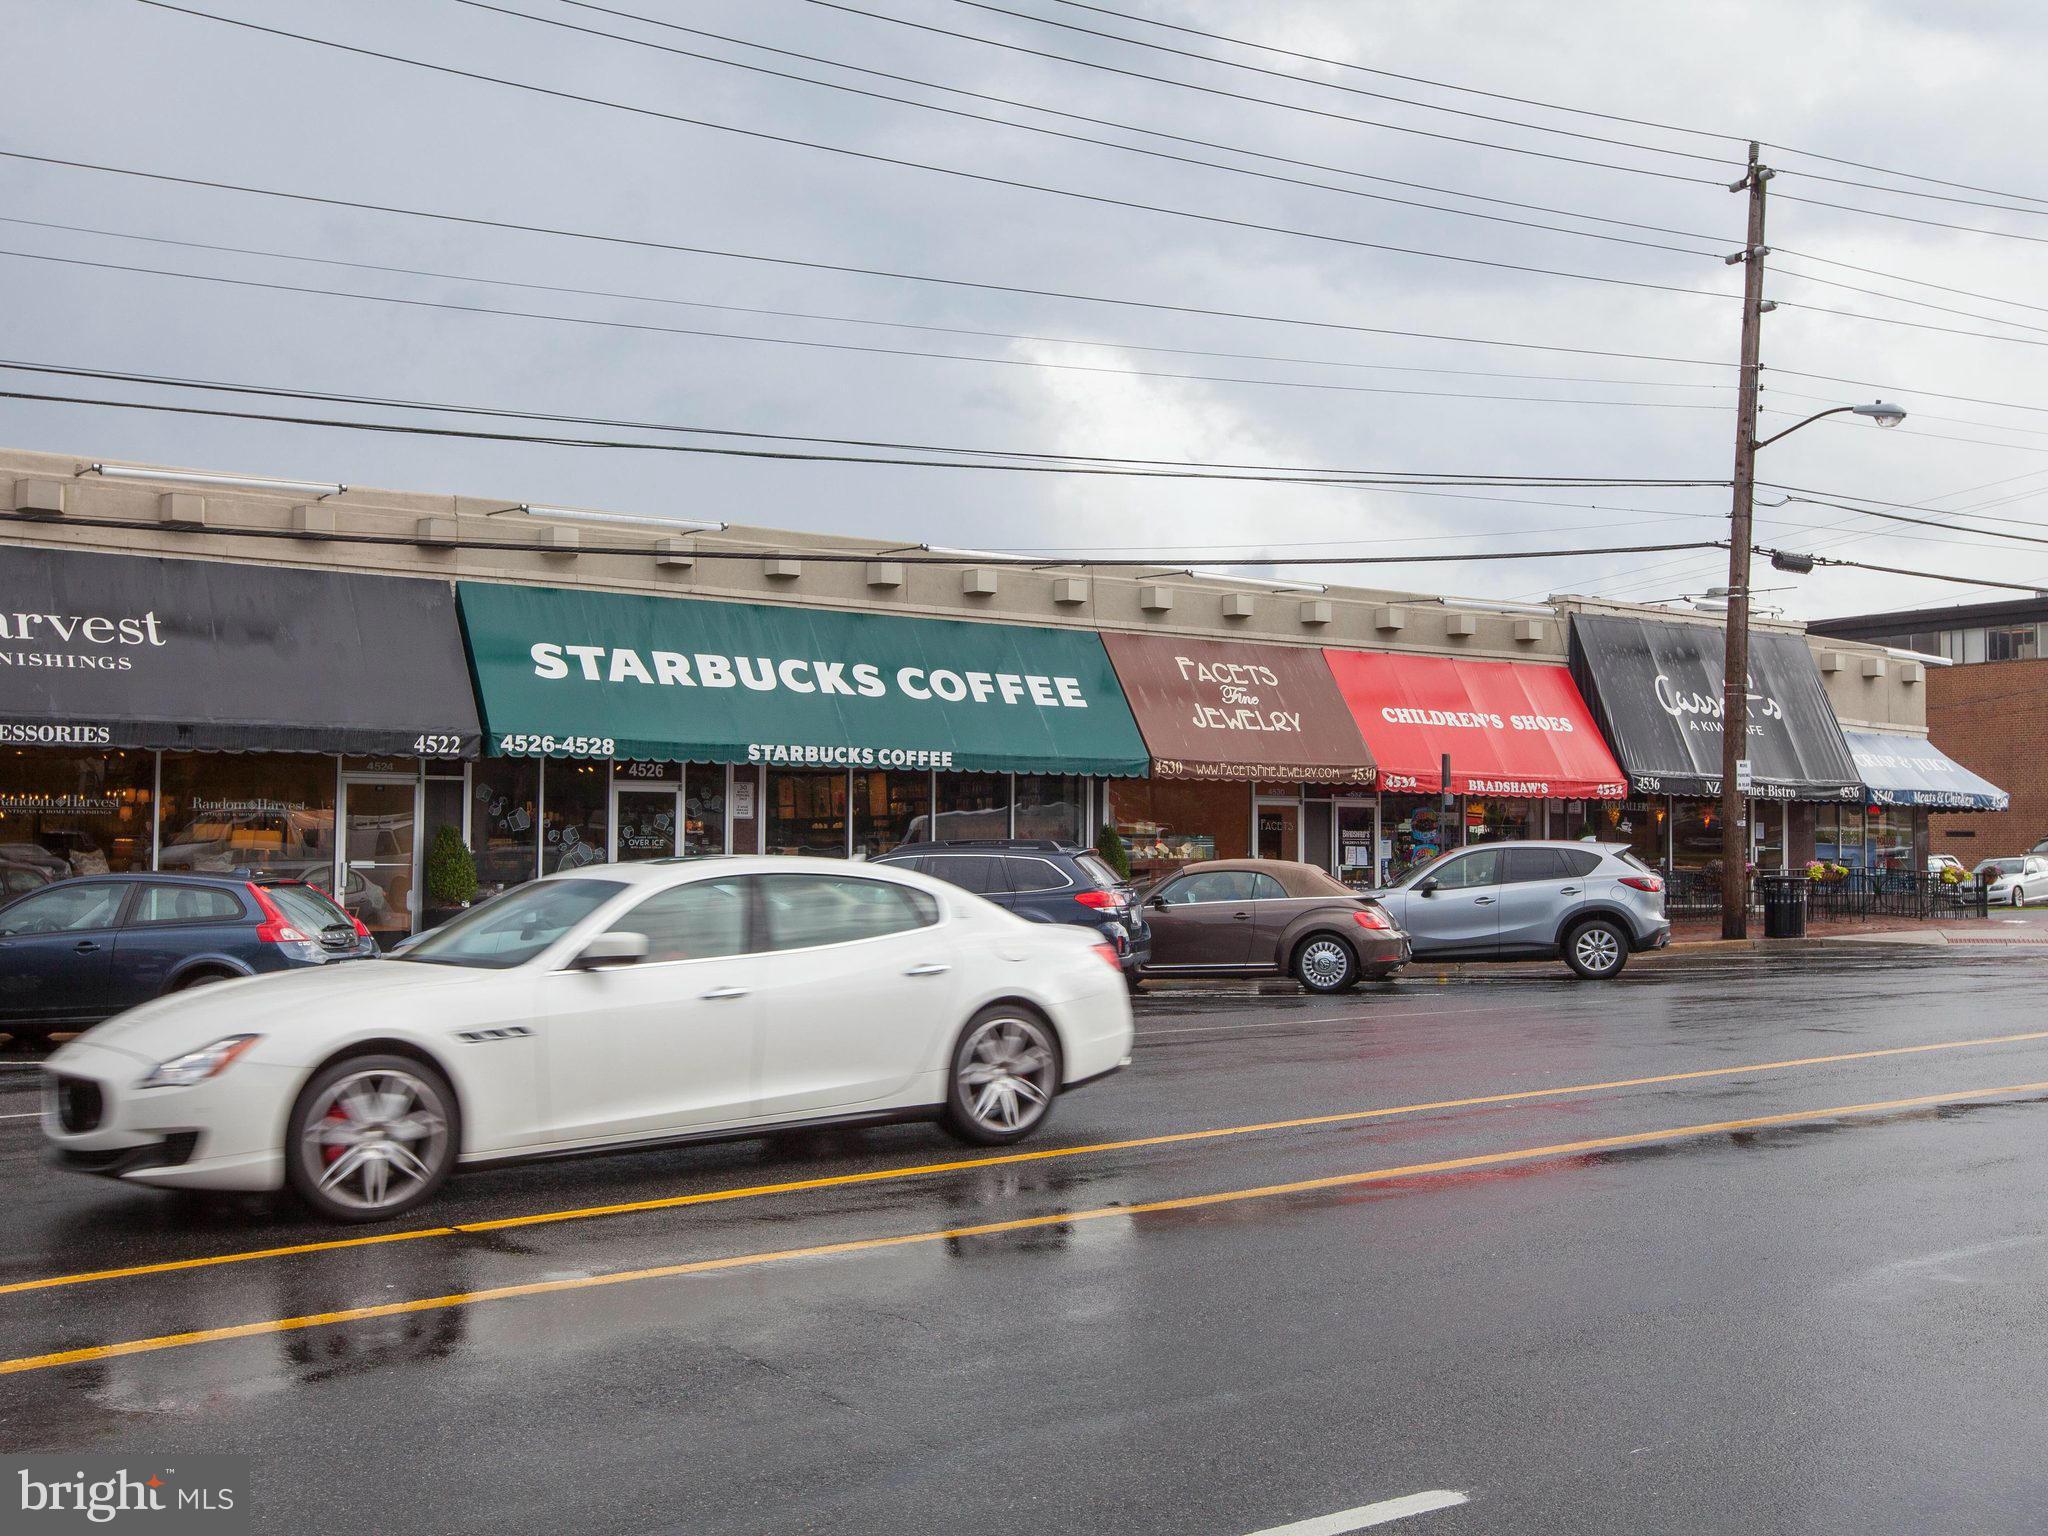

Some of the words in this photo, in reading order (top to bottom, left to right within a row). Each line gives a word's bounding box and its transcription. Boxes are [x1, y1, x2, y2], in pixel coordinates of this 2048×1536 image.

[530, 643, 887, 698] STARBUCKS
[897, 667, 1088, 708] COFFEE
[1175, 656, 1279, 686] FACETS
[1220, 685, 1259, 704] Fine
[1192, 703, 1301, 731] JEWELRY
[1381, 707, 1504, 729] CHILDREN'S
[1510, 715, 1574, 732] SHOES
[1690, 720, 1700, 731] A
[1702, 721, 1725, 732] KIW
[413, 734, 461, 754] 4522
[500, 734, 615, 755] 4526-4528
[747, 743, 874, 764] STARBUCKS
[878, 749, 953, 767] COFFEE
[366, 761, 393, 771] 4524
[628, 763, 664, 777] 4526
[1155, 760, 1183, 775] 4530
[1196, 763, 1340, 778] WWW.FACETSFINEJEWELRY.COM
[1351, 767, 1376, 781] 4530
[1385, 776, 1417, 788] 4532
[1468, 779, 1549, 794] BRADSHAW'S
[1638, 776, 1661, 791] 4536
[1705, 781, 1721, 794] NZ
[1768, 785, 1796, 798] Bistro
[1597, 784, 1624, 796] 4532
[1839, 786, 1860, 798] 4536
[66, 794, 119, 808] Harvest
[192, 797, 246, 810] Random
[1260, 819, 1294, 831] FACETS
[651, 839, 665, 847] ICE
